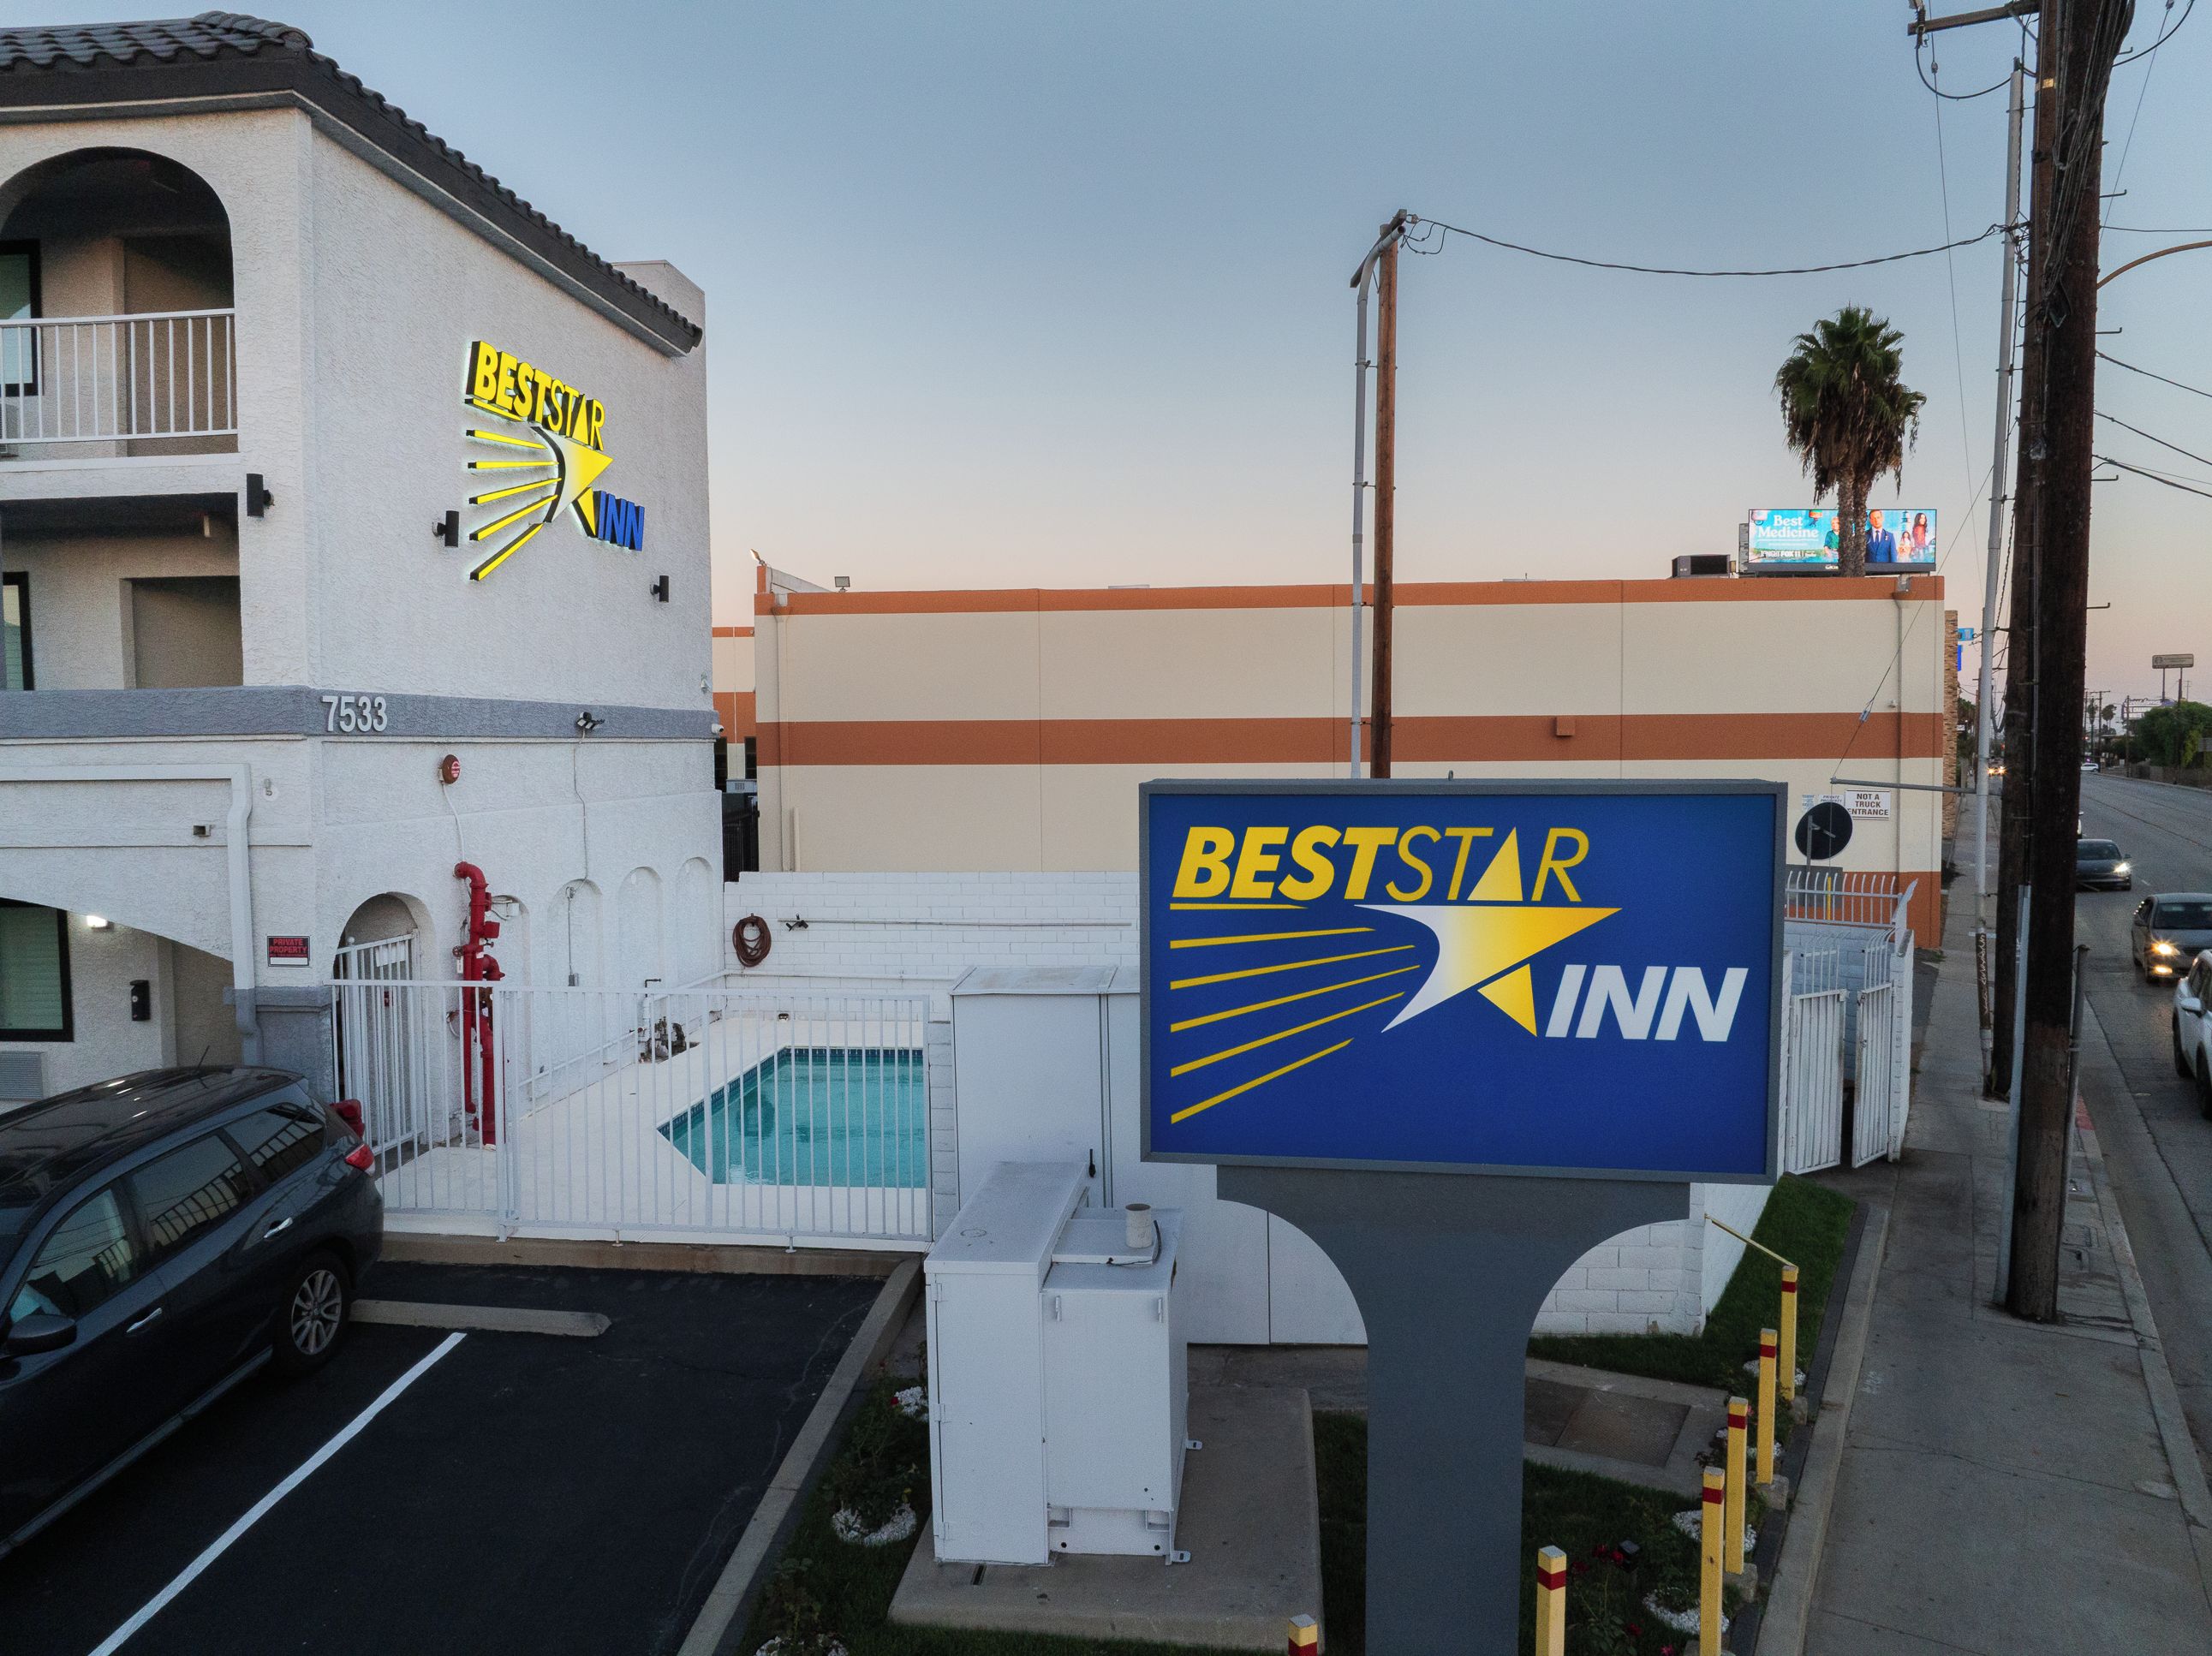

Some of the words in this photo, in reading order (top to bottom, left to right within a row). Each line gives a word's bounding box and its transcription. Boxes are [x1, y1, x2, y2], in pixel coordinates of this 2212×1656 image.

[593, 491, 645, 551] INN
[1758, 526, 1819, 539] Medicine
[1774, 515, 1803, 527] Best
[320, 695, 388, 733] 7533
[1545, 964, 1750, 1043] INN
